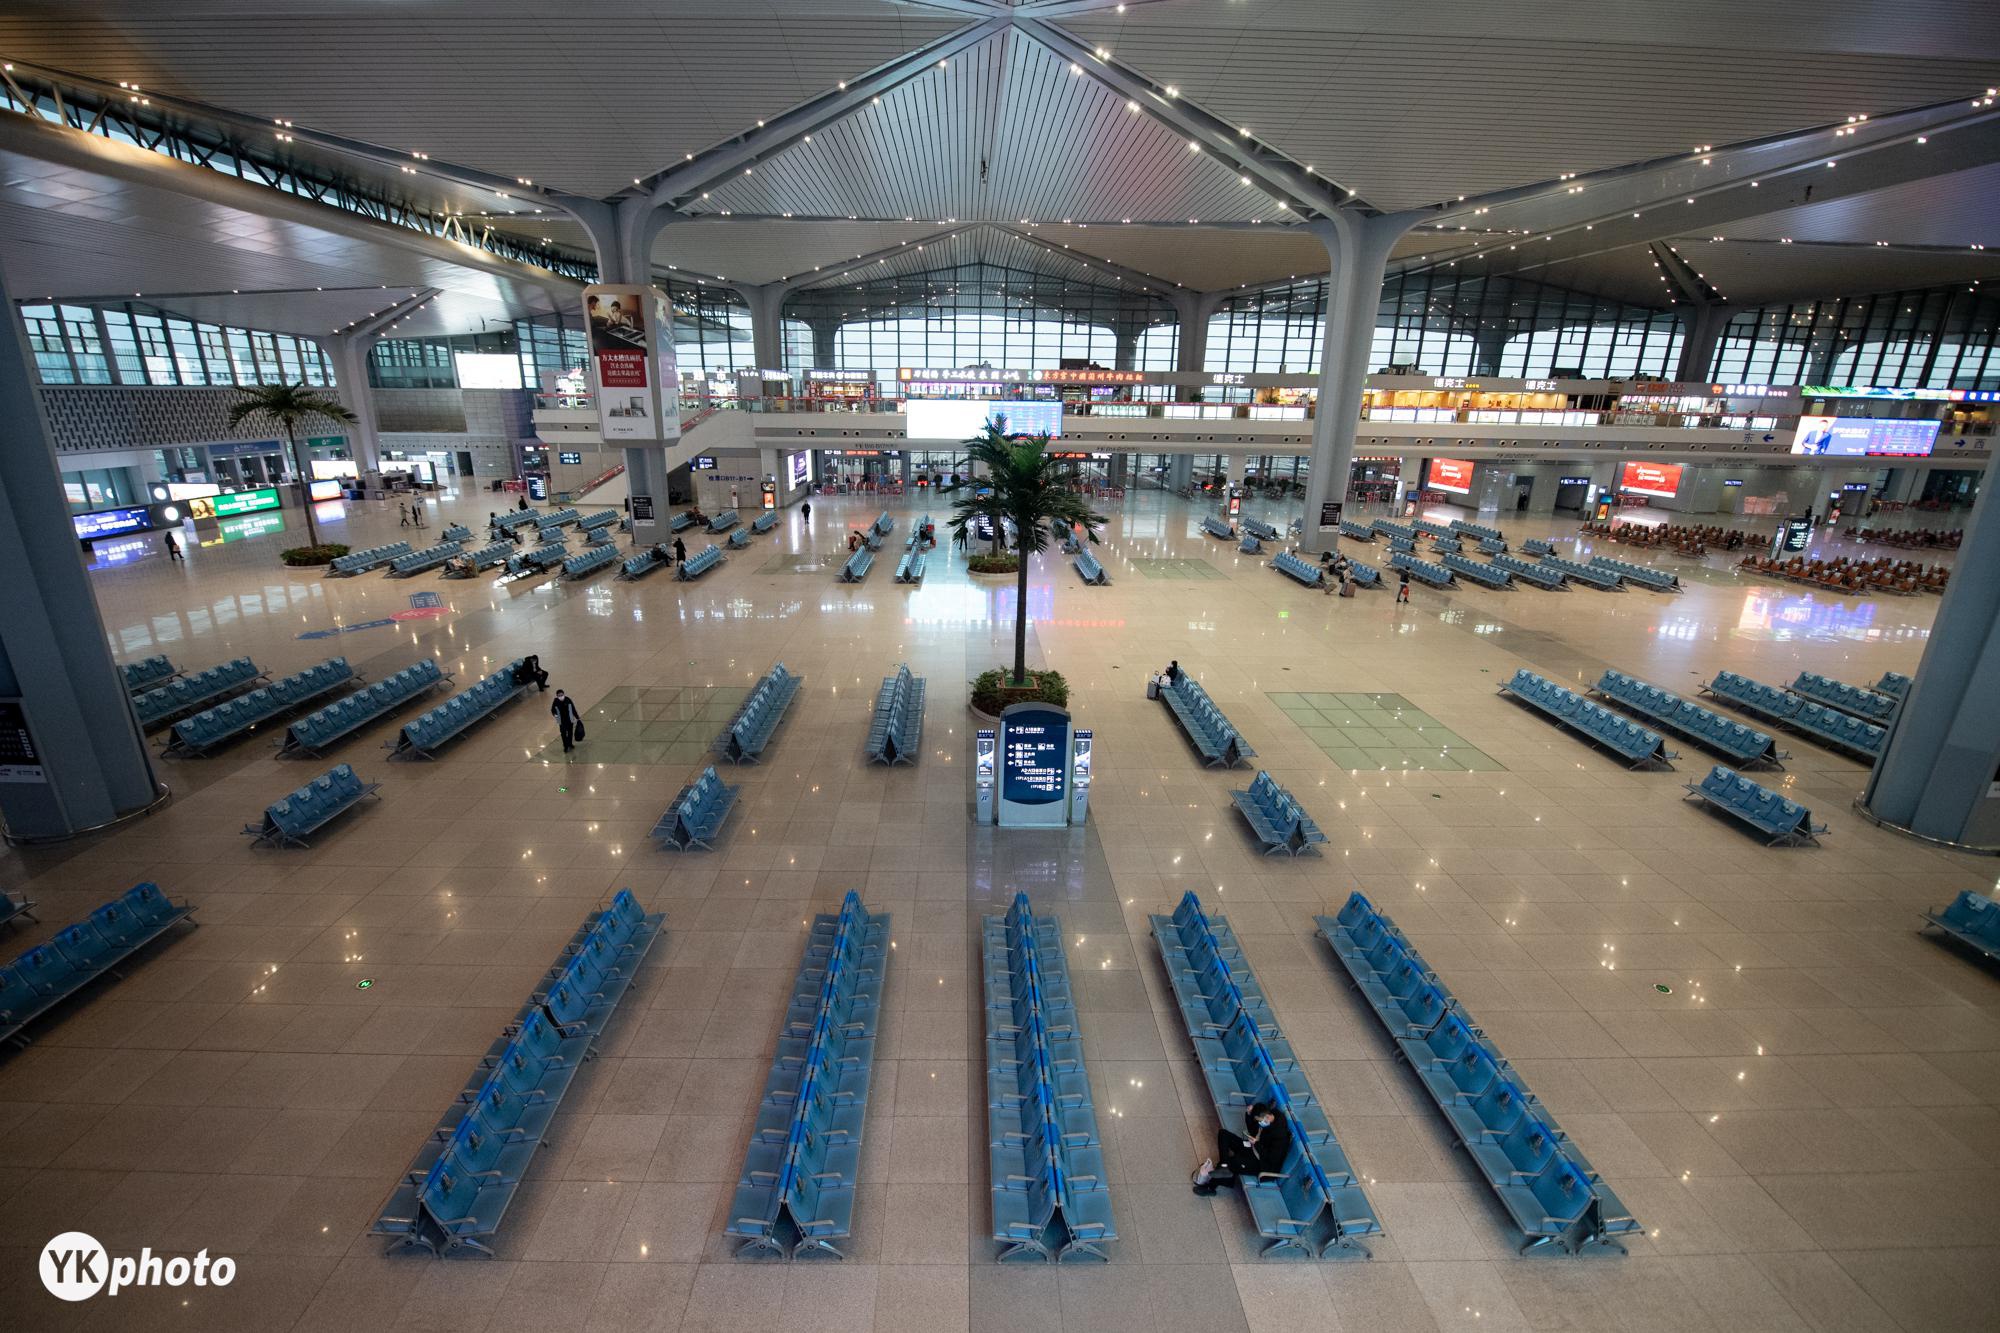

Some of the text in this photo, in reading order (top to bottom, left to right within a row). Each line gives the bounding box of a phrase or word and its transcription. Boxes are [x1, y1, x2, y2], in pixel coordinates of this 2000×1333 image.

[1213, 373, 1245, 384] 德克士
[1434, 378, 1465, 388] 德克士
[1525, 380, 1557, 390] 德克士
[1744, 431, 1755, 443] 东
